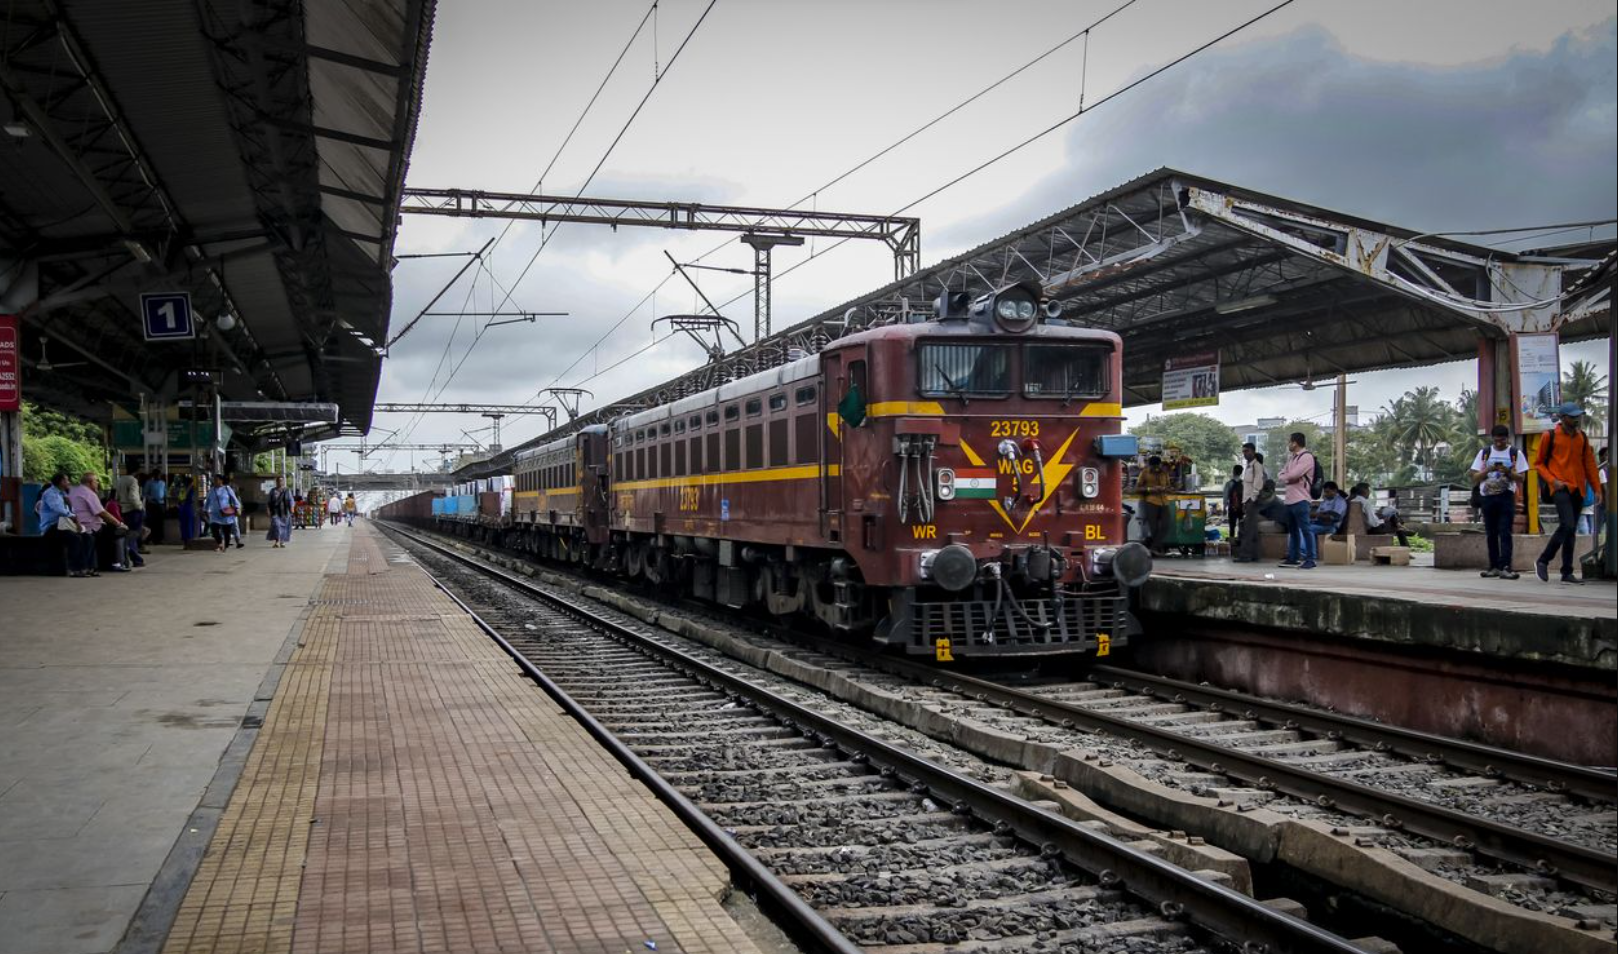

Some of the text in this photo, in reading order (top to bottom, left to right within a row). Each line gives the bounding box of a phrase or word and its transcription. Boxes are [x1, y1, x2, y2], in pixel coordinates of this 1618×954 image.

[157, 301, 177, 329] 1
[991, 420, 1039, 437] 23793
[997, 459, 1034, 475] WAG
[912, 525, 937, 539] WR
[1085, 524, 1106, 540] BL
